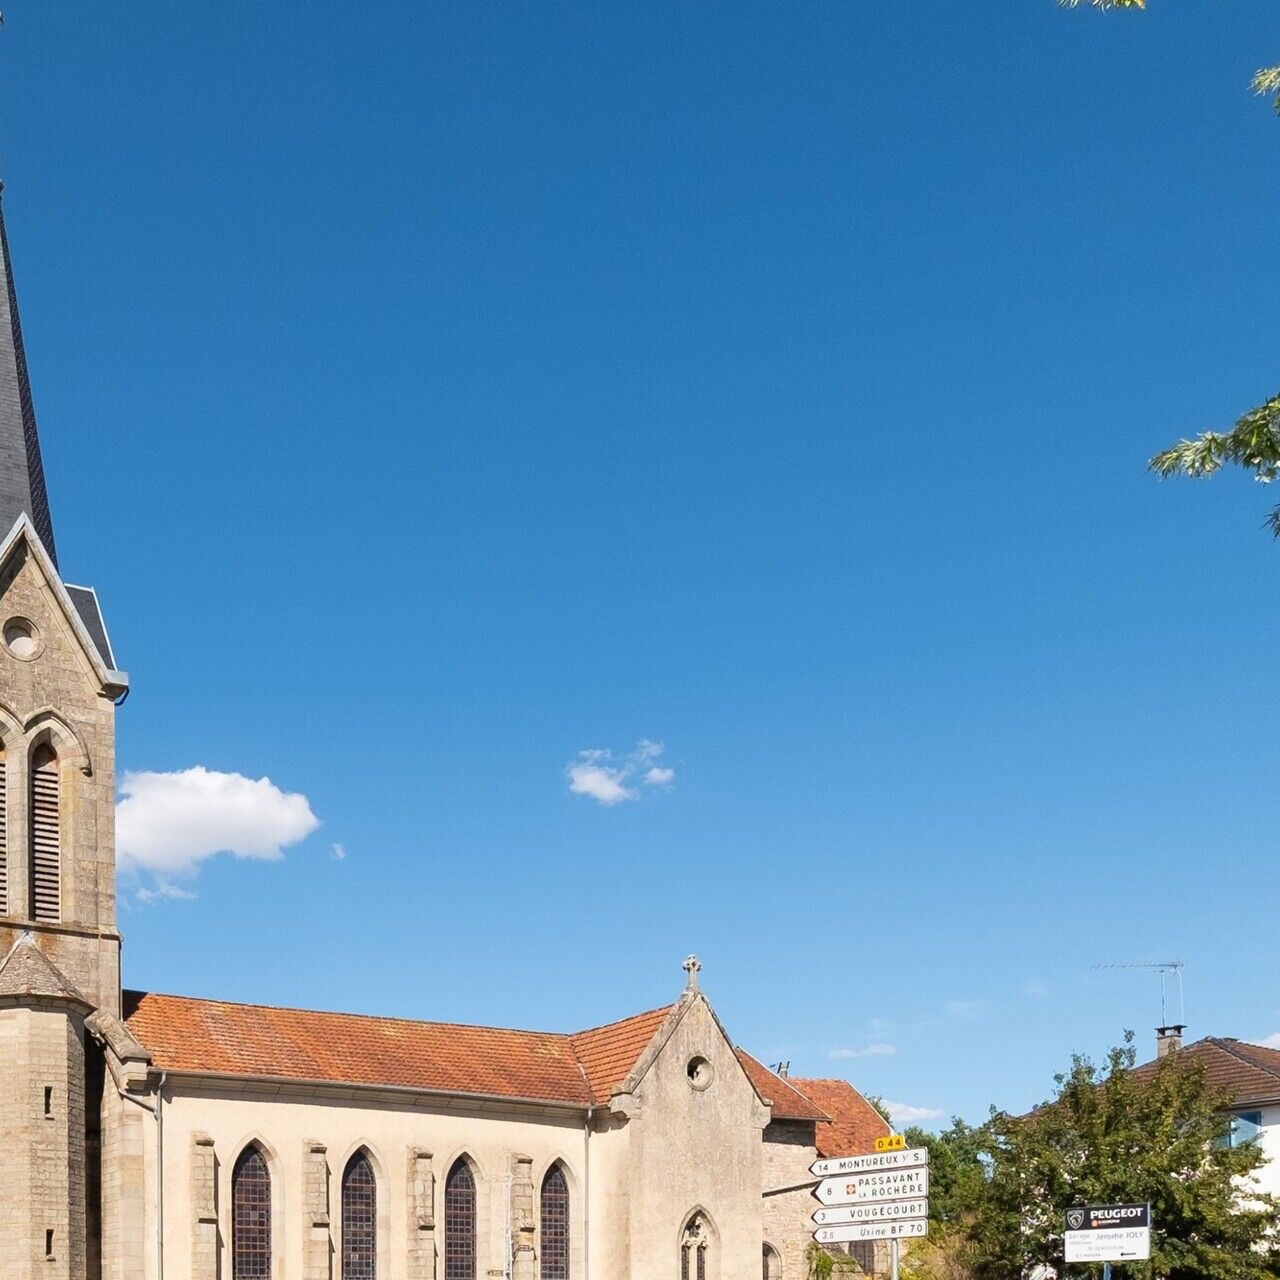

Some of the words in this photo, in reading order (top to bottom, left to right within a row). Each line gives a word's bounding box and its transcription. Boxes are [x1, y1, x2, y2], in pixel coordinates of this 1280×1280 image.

[878, 1140, 884, 1149] D
[888, 1139, 900, 1147] 44
[818, 1164, 829, 1172] 14
[839, 1155, 898, 1170] MONTUREUX
[859, 1173, 920, 1186] PASSAVANT
[821, 1212, 826, 1221] 3
[1090, 1207, 1144, 1219] PEUGEOT
[860, 1228, 886, 1237] Usine
[891, 1226, 904, 1235] BF
[910, 1224, 923, 1233] 70
[1125, 1230, 1144, 1239] JOLY
